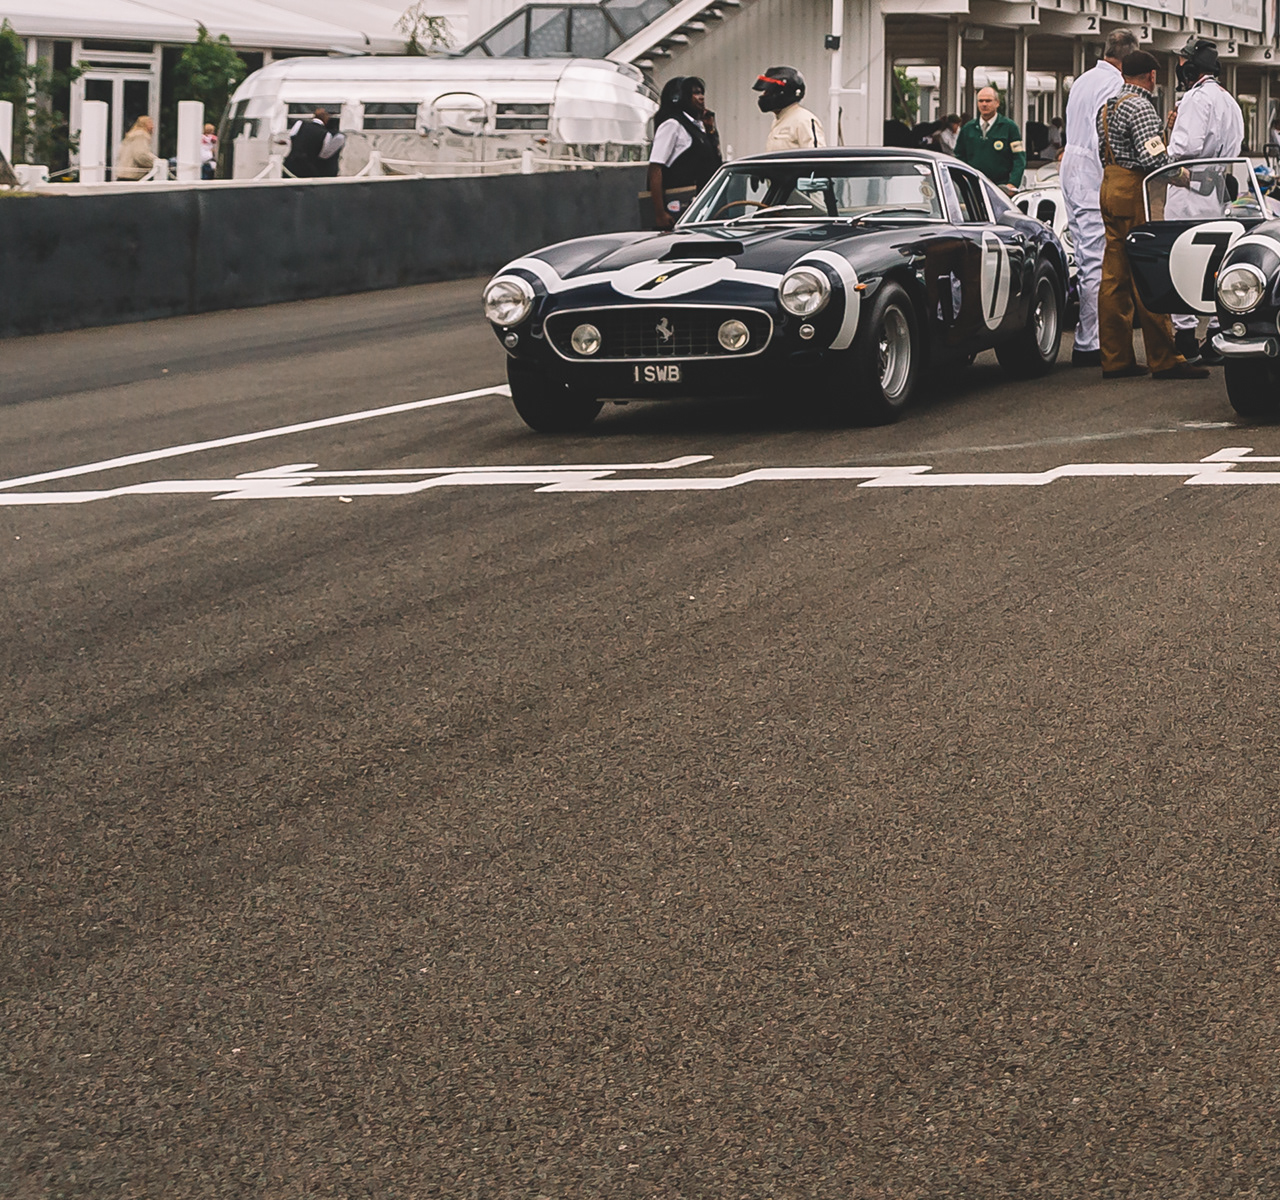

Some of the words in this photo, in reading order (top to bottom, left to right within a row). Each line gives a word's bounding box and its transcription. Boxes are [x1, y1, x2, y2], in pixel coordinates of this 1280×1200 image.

[1087, 17, 1096, 30] 2
[1140, 26, 1149, 39] 3
[1228, 41, 1235, 53] 5
[1264, 48, 1272, 60] 6
[1191, 232, 1233, 301] 7
[634, 261, 714, 291] 7
[984, 239, 1002, 318] 7
[644, 365, 680, 382] SWB
